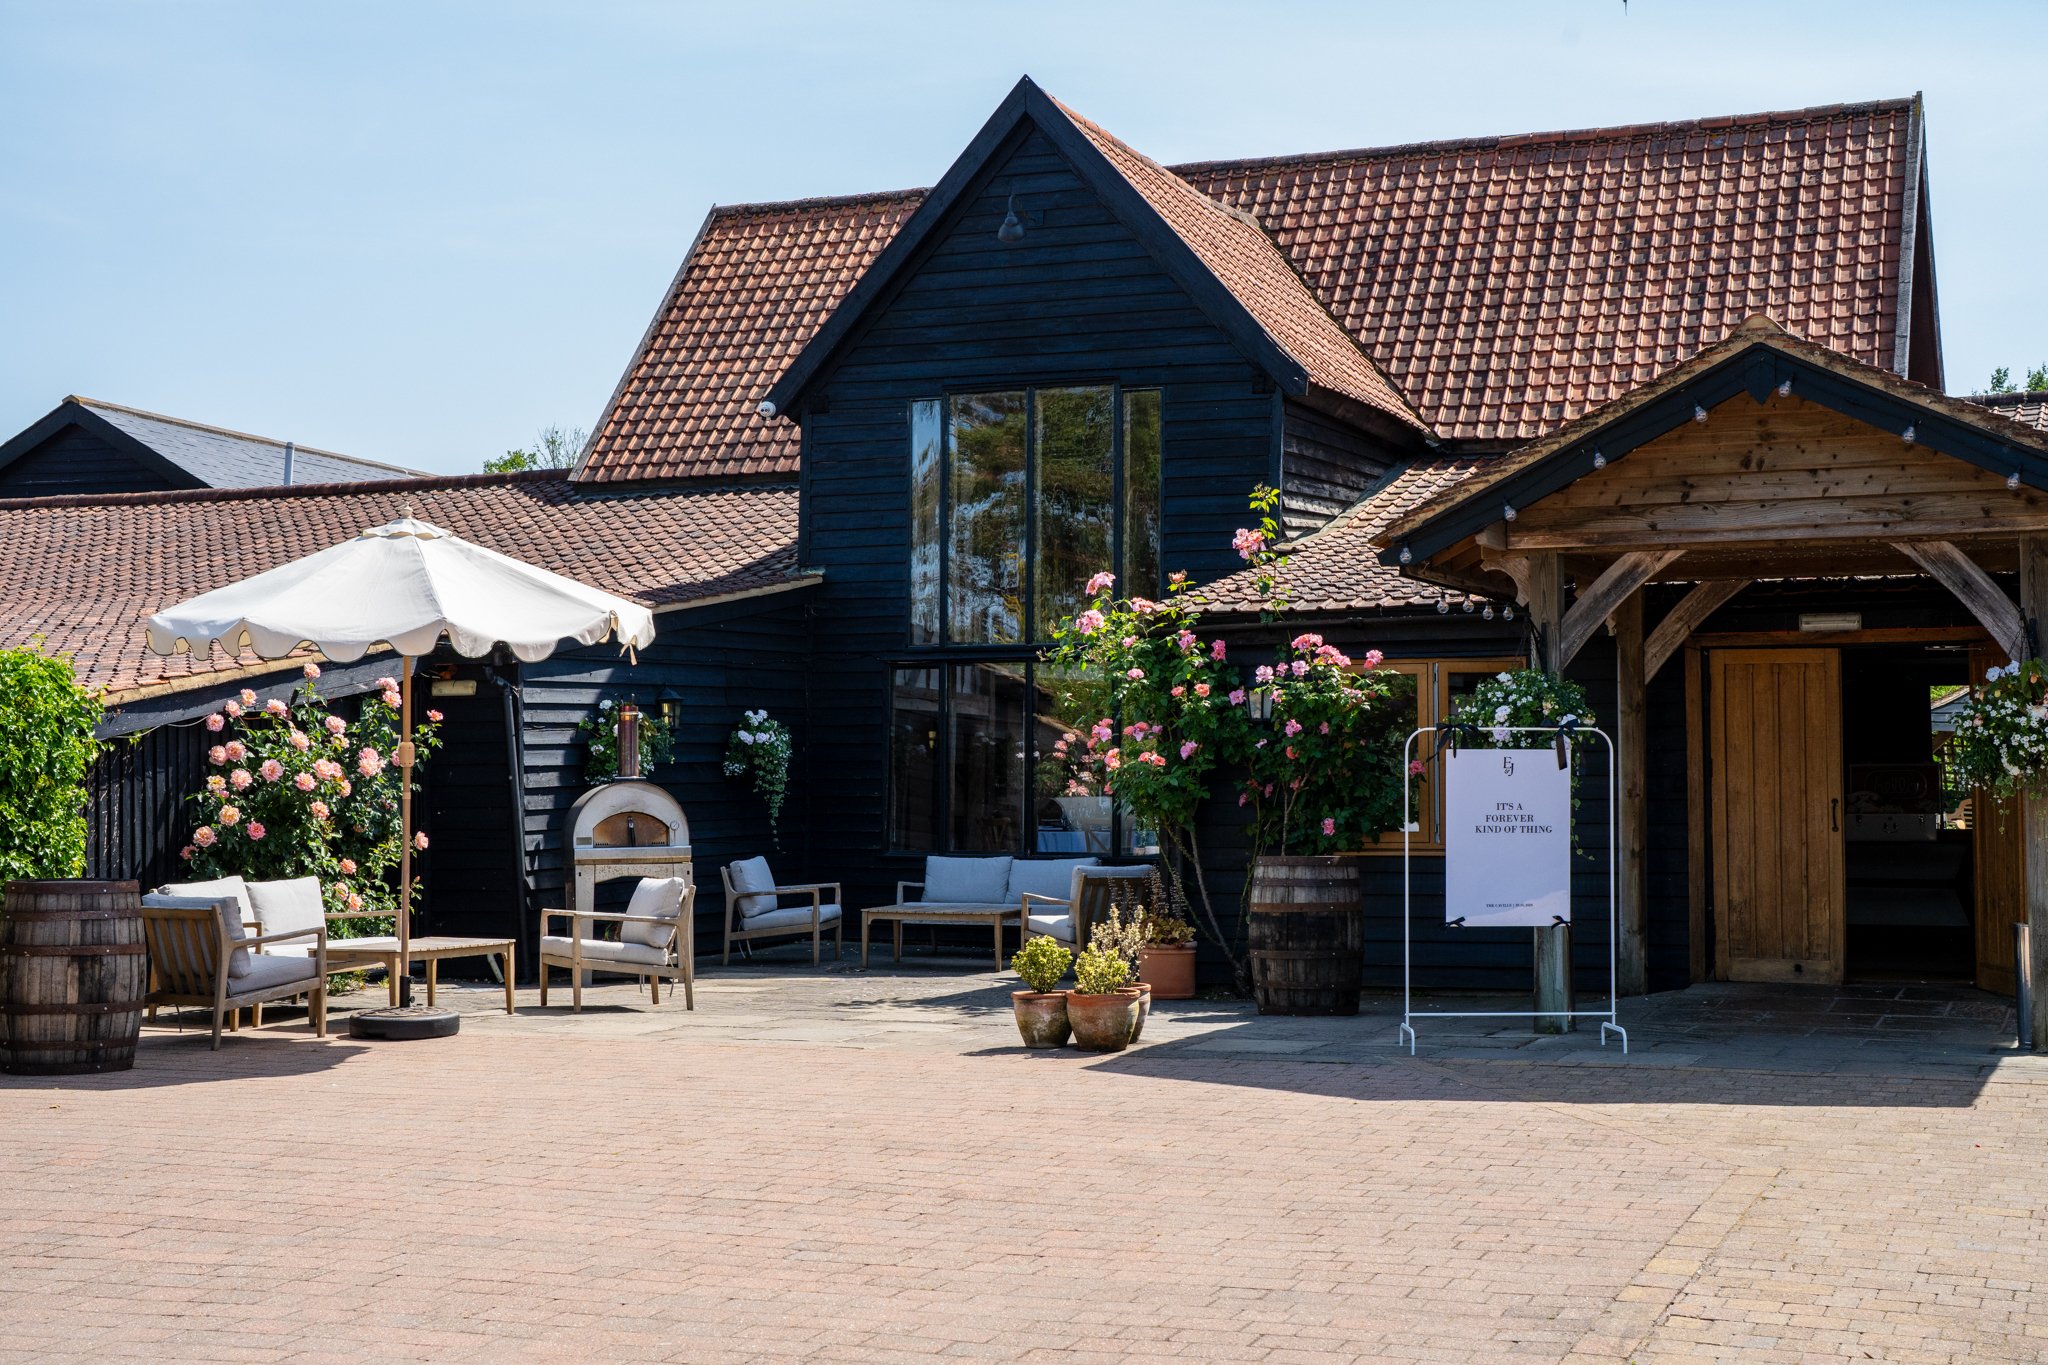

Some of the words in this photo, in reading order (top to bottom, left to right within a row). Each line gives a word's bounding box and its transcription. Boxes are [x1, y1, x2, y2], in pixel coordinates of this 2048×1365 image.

[1496, 802, 1514, 811] IT'S
[1516, 803, 1523, 811] A
[1485, 814, 1534, 823] FOREVER
[1475, 825, 1502, 834] KIND
[1503, 825, 1518, 834] OF
[1519, 825, 1553, 834] THING
